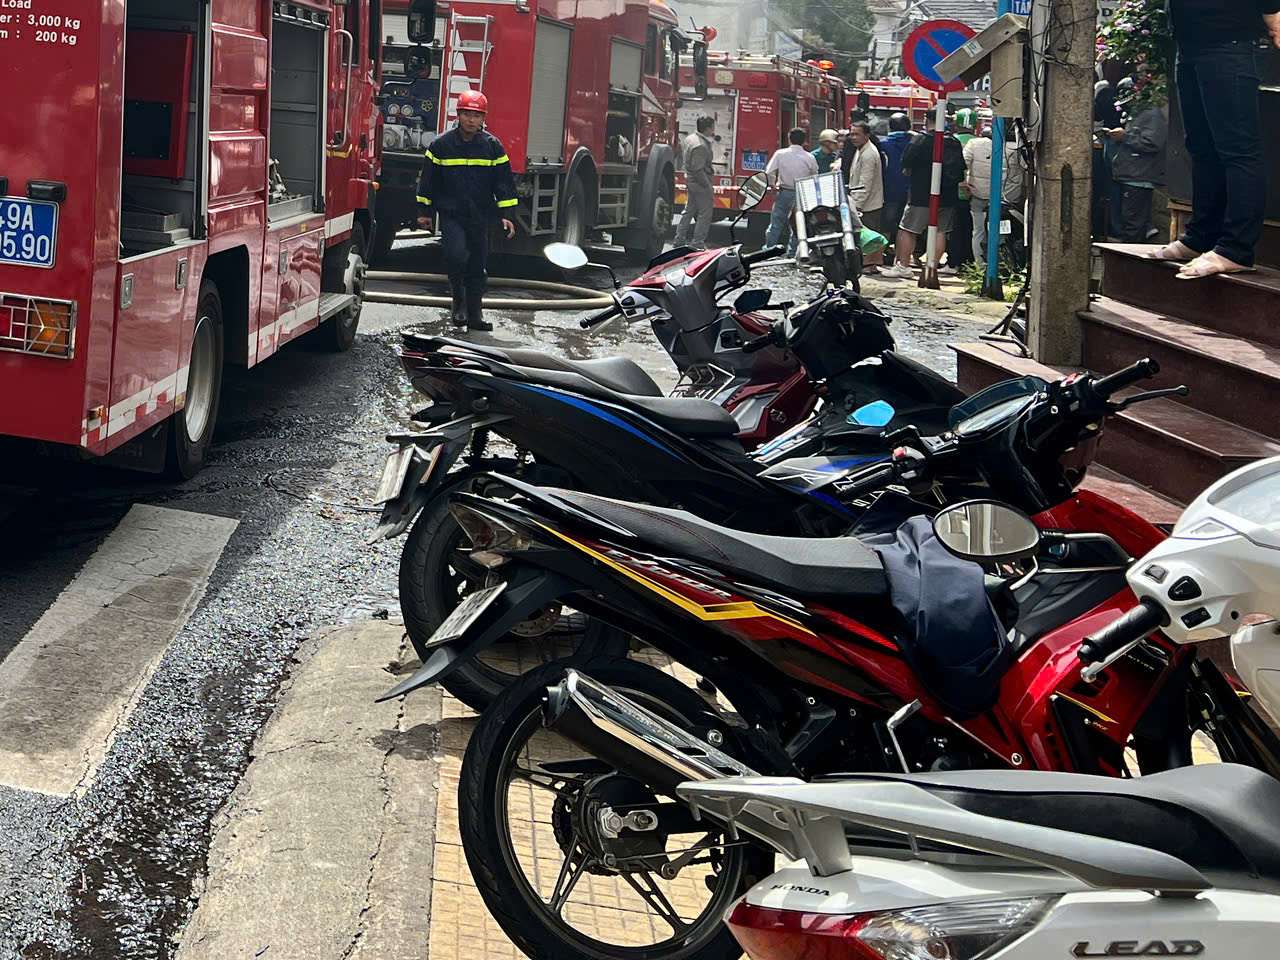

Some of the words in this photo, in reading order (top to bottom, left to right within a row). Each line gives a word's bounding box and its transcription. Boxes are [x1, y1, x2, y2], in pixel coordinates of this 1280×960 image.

[27, 14, 61, 27] 3,000
[65, 17, 81, 30] kg
[35, 30, 57, 42] 200
[61, 32, 77, 45] kg
[771, 884, 830, 897] HONDA
[1070, 940, 1206, 959] LEAD
